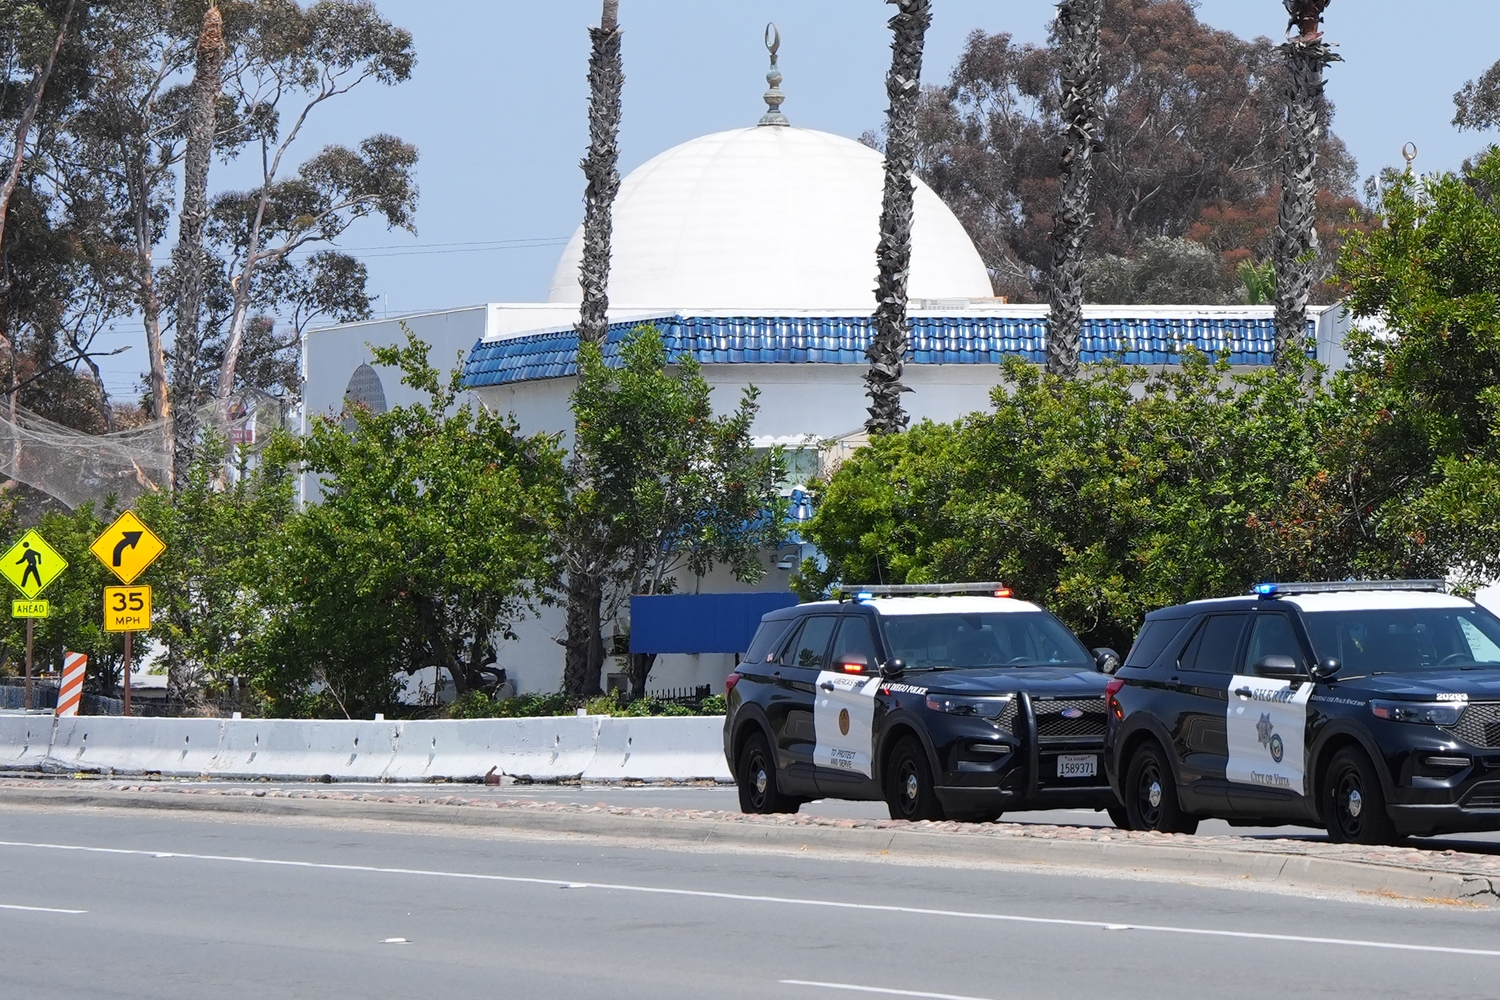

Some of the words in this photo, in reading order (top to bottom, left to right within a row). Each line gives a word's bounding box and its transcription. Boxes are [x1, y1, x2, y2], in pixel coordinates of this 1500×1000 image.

[112, 593, 144, 612] 35
[16, 604, 45, 614] AHEAD
[115, 617, 140, 626] MPH
[890, 683, 908, 692] DIEGO
[907, 686, 929, 696] POLICE
[1253, 688, 1297, 704] SHERIFF
[1060, 762, 1095, 774] 1589371
